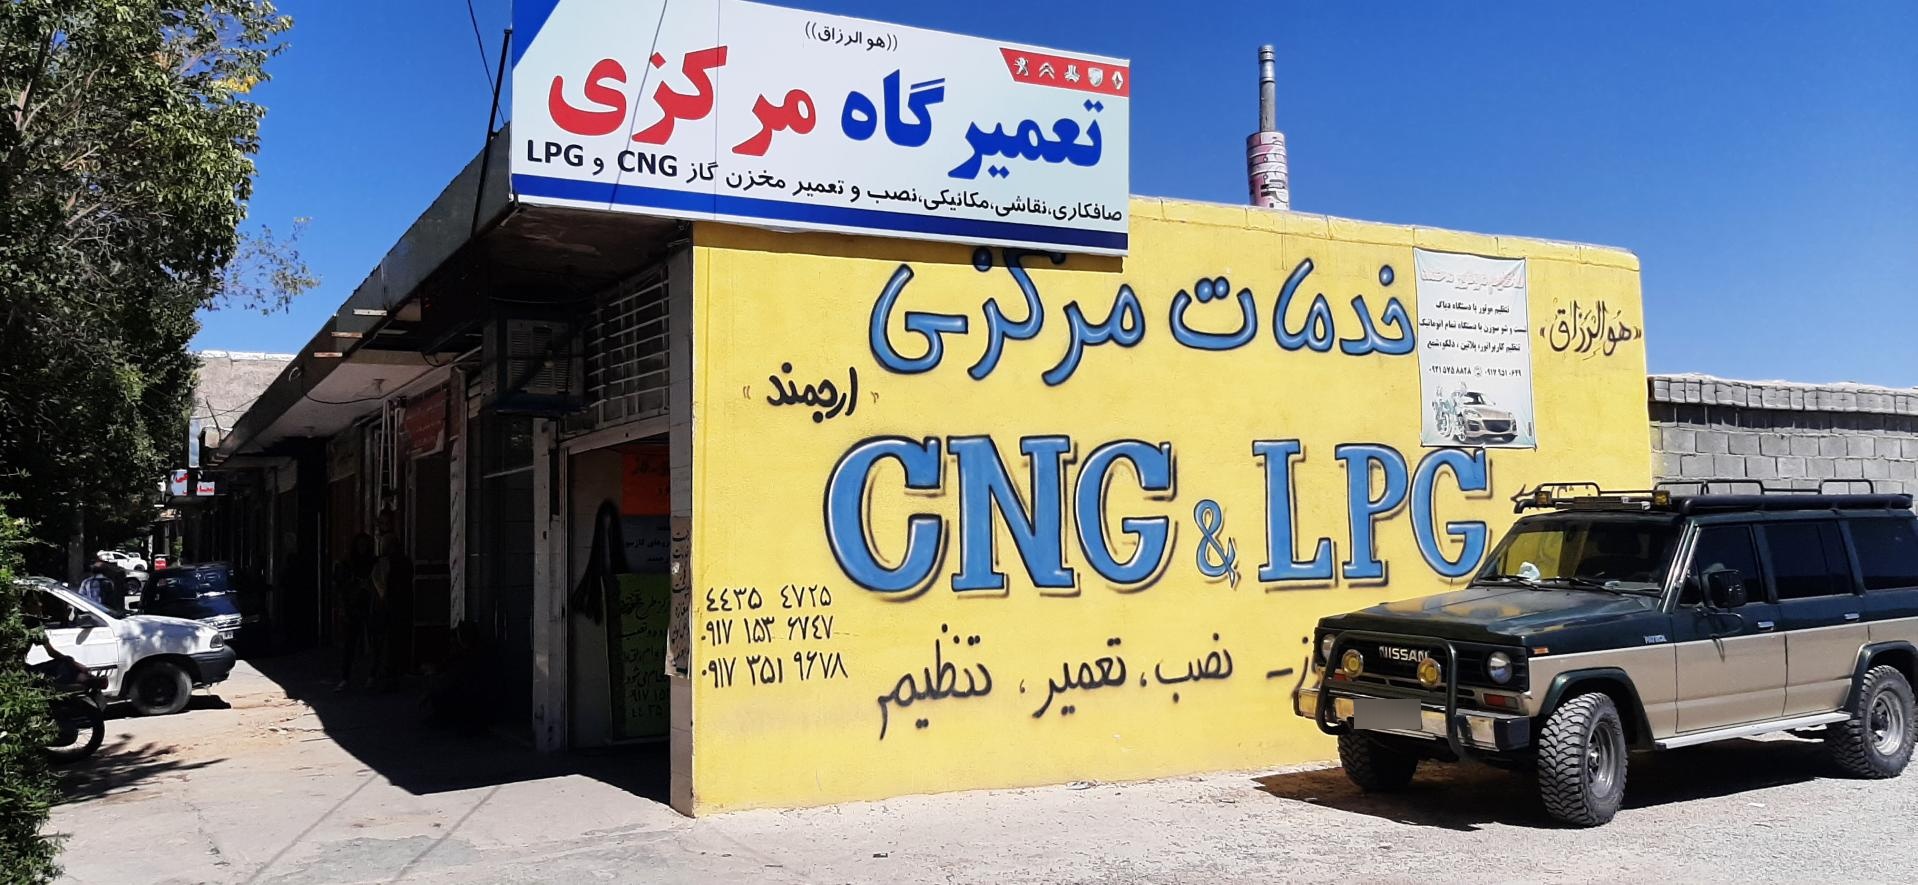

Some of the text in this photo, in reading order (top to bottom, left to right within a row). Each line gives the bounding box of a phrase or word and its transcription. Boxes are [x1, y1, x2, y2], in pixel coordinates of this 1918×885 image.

[527, 139, 584, 167] LPG
[616, 149, 678, 178] CNG
[592, 157, 605, 176] و
[685, 161, 719, 184] گاز
[725, 170, 787, 191] مخزن
[791, 179, 844, 197] تعمیر
[850, 185, 861, 202] و
[868, 246, 1419, 387] خدمات مرکزی
[1452, 302, 1472, 311] دستگاه
[823, 434, 1489, 593] CNG & LPG
[1379, 645, 1429, 662] NISSAN
[877, 623, 993, 742] تنظیم
